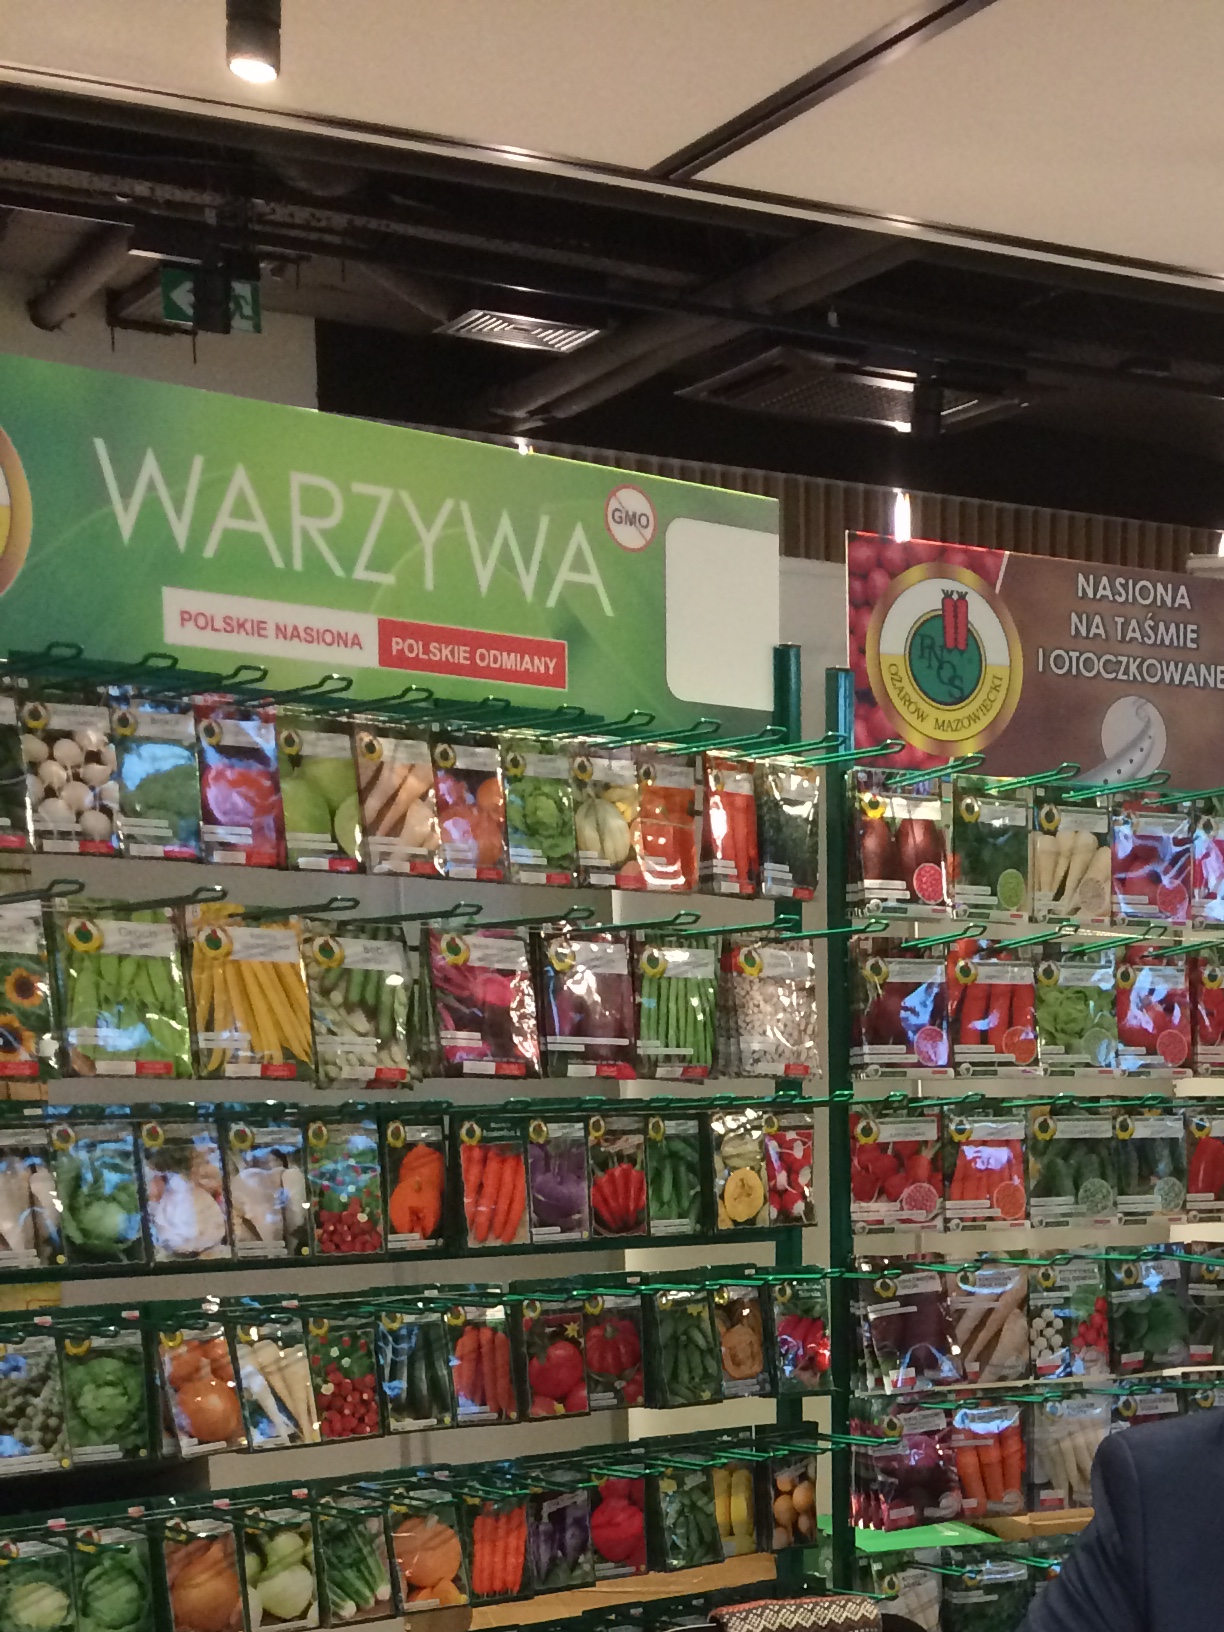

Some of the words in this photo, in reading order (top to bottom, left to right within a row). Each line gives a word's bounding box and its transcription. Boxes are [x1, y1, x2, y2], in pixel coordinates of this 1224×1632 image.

[93, 437, 615, 616] WARZYWA
[611, 506, 651, 532] GMO
[1077, 572, 1193, 611] NASIONA
[179, 609, 269, 640] POLSKIE
[273, 619, 364, 652] NASIONA
[1070, 611, 1106, 641] NA
[1115, 612, 1200, 650] TAŚMIE
[390, 636, 471, 668] POLSKIE
[474, 646, 557, 677] ODMIANY
[1038, 651, 1044, 673] I
[933, 674, 1003, 733] MAZOWIECKI
